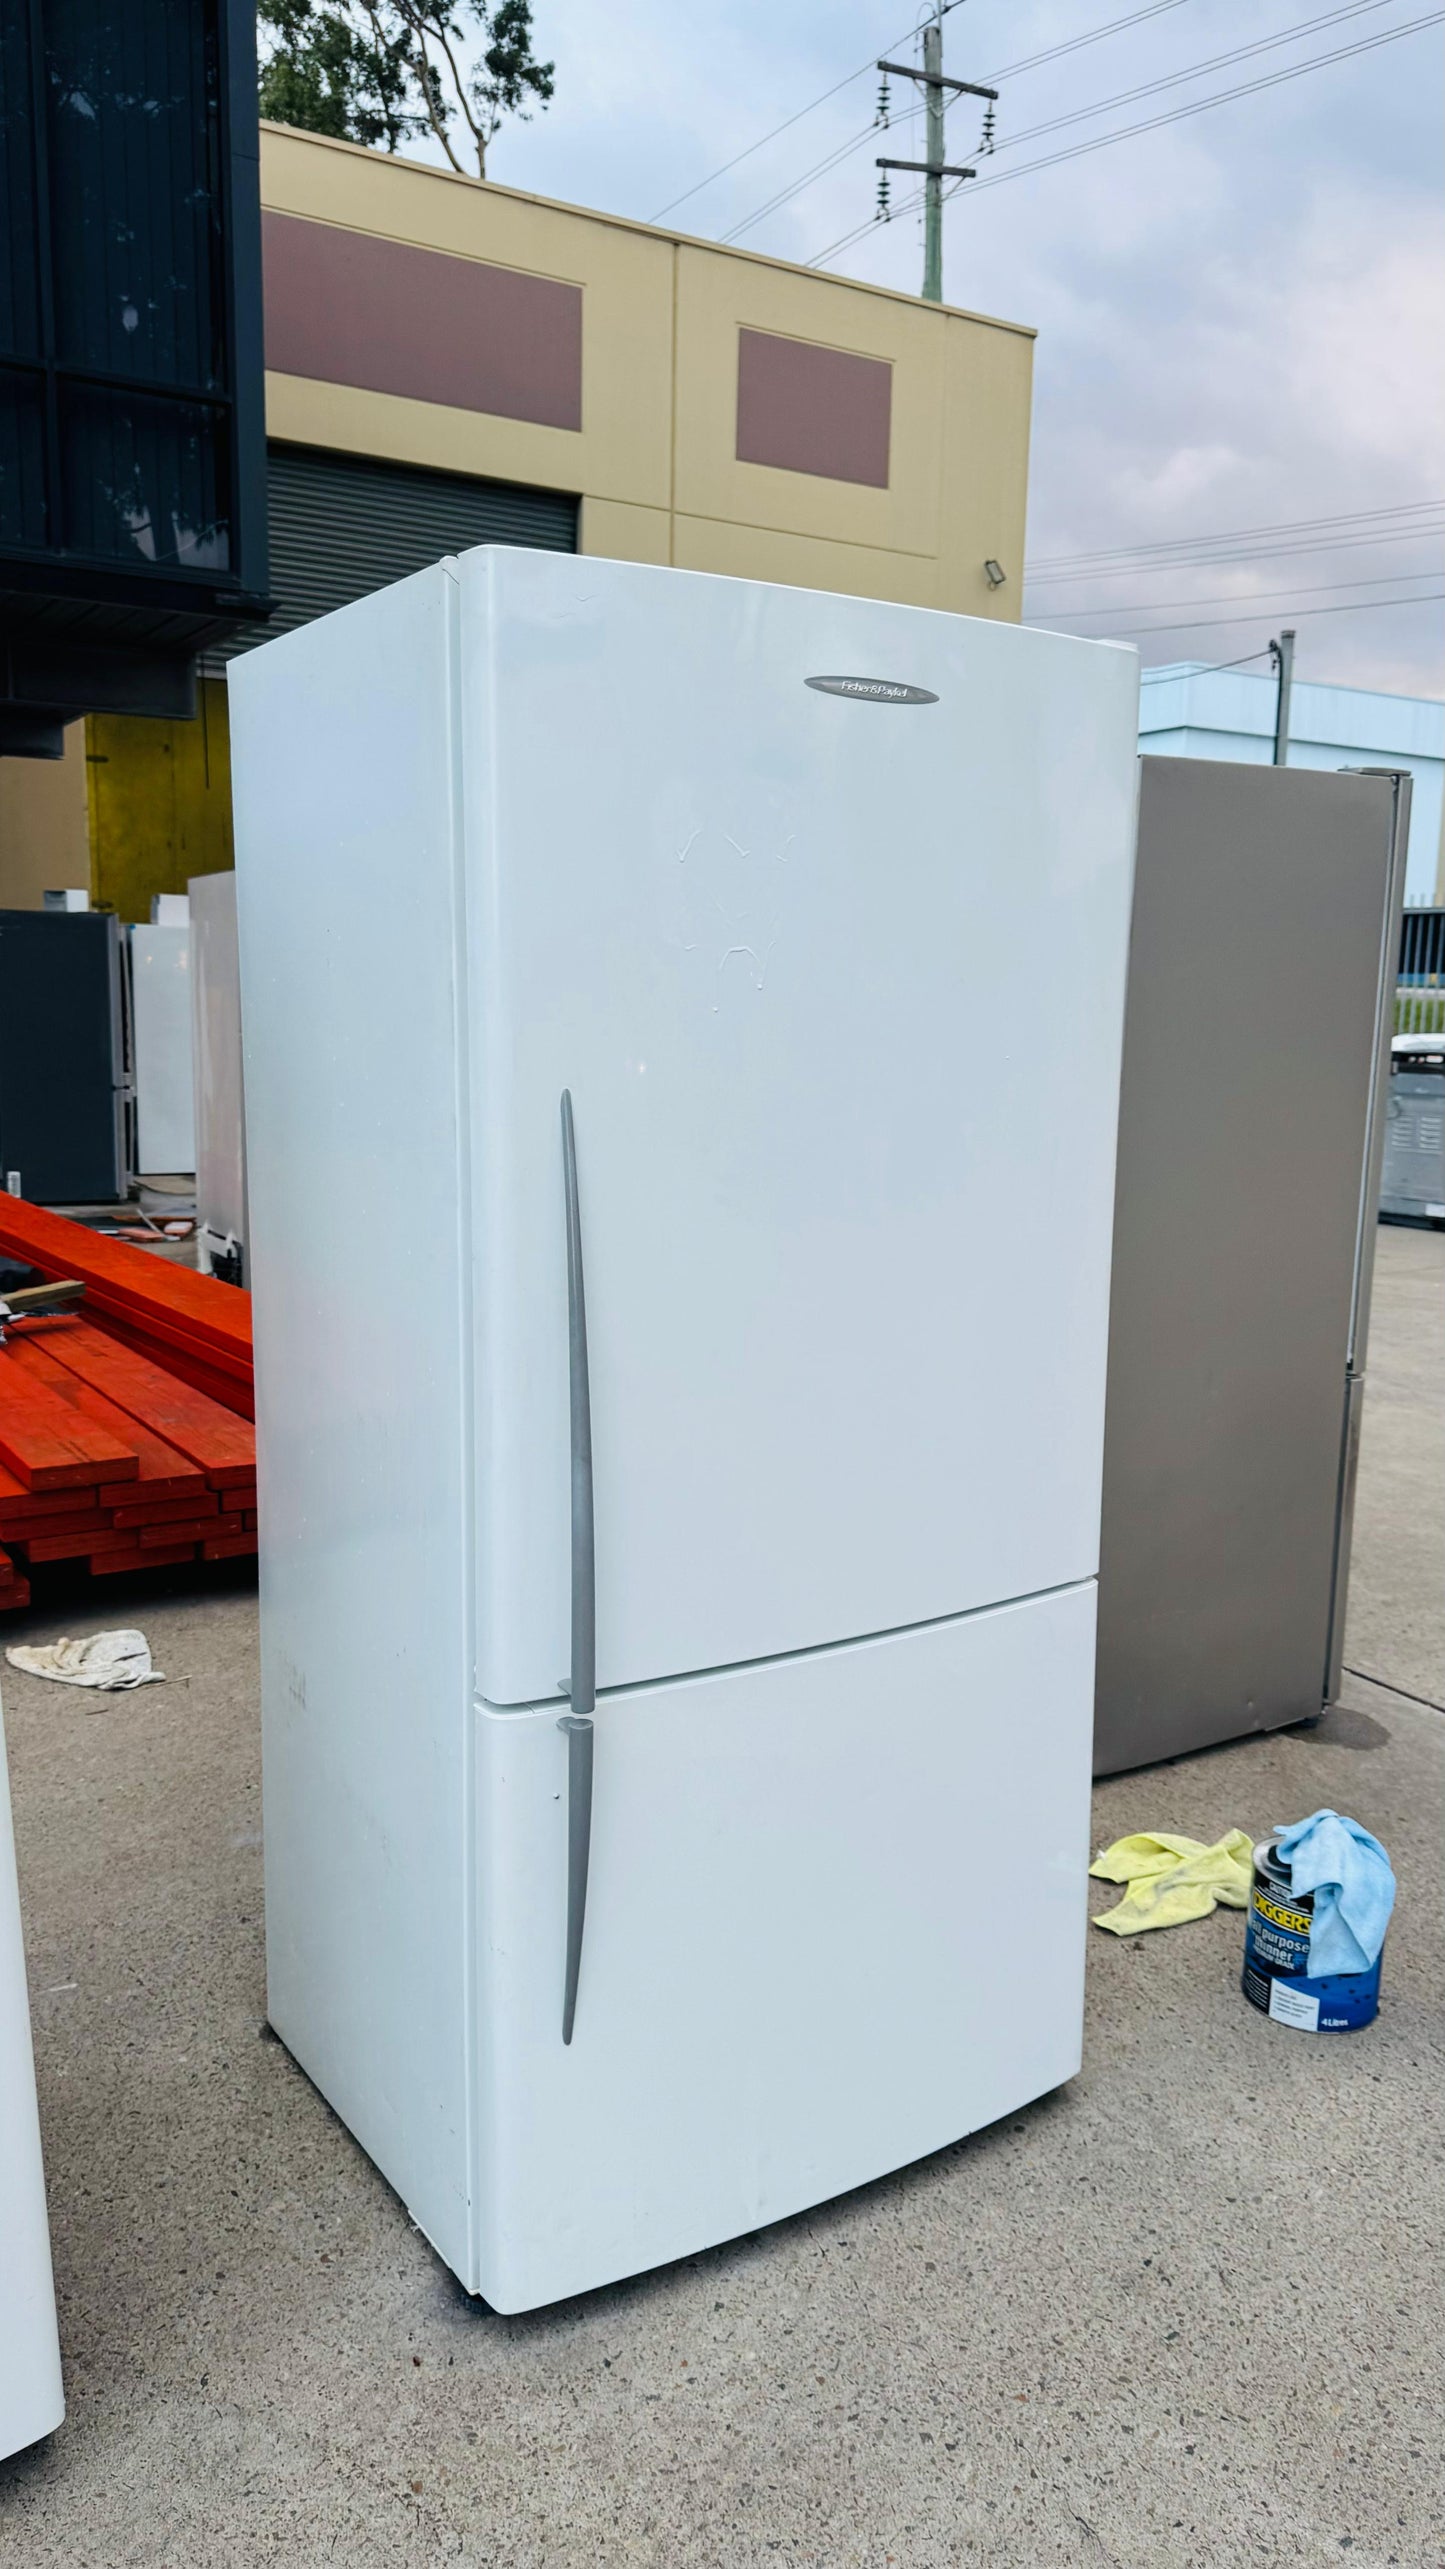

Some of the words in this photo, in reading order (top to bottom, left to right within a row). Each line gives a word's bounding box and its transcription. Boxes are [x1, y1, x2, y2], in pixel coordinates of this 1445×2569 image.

[1253, 1890, 1313, 1935] DIGGERS
[1254, 1934, 1294, 1962] thinner
[1262, 1928, 1310, 1954] purpose
